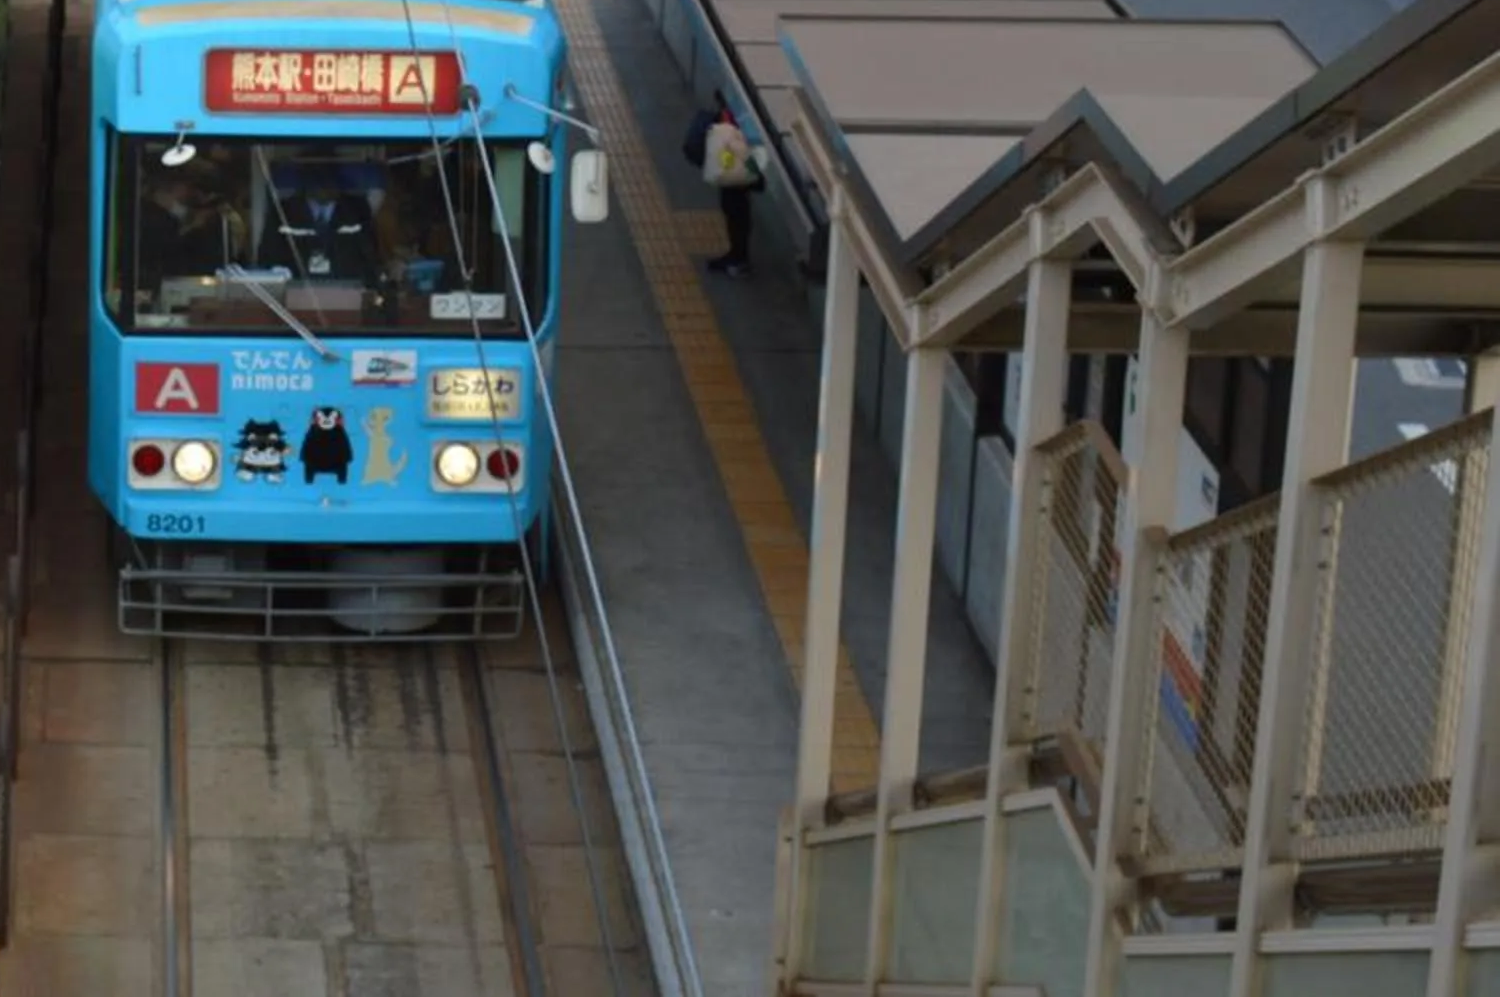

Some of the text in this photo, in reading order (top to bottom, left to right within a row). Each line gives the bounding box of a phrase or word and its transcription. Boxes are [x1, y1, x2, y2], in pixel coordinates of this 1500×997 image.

[396, 63, 427, 95] A
[232, 350, 313, 370] でんでん
[154, 366, 199, 410] A
[232, 373, 314, 392] nimoca
[432, 372, 515, 396] しらかわ
[147, 514, 206, 533] 8201
